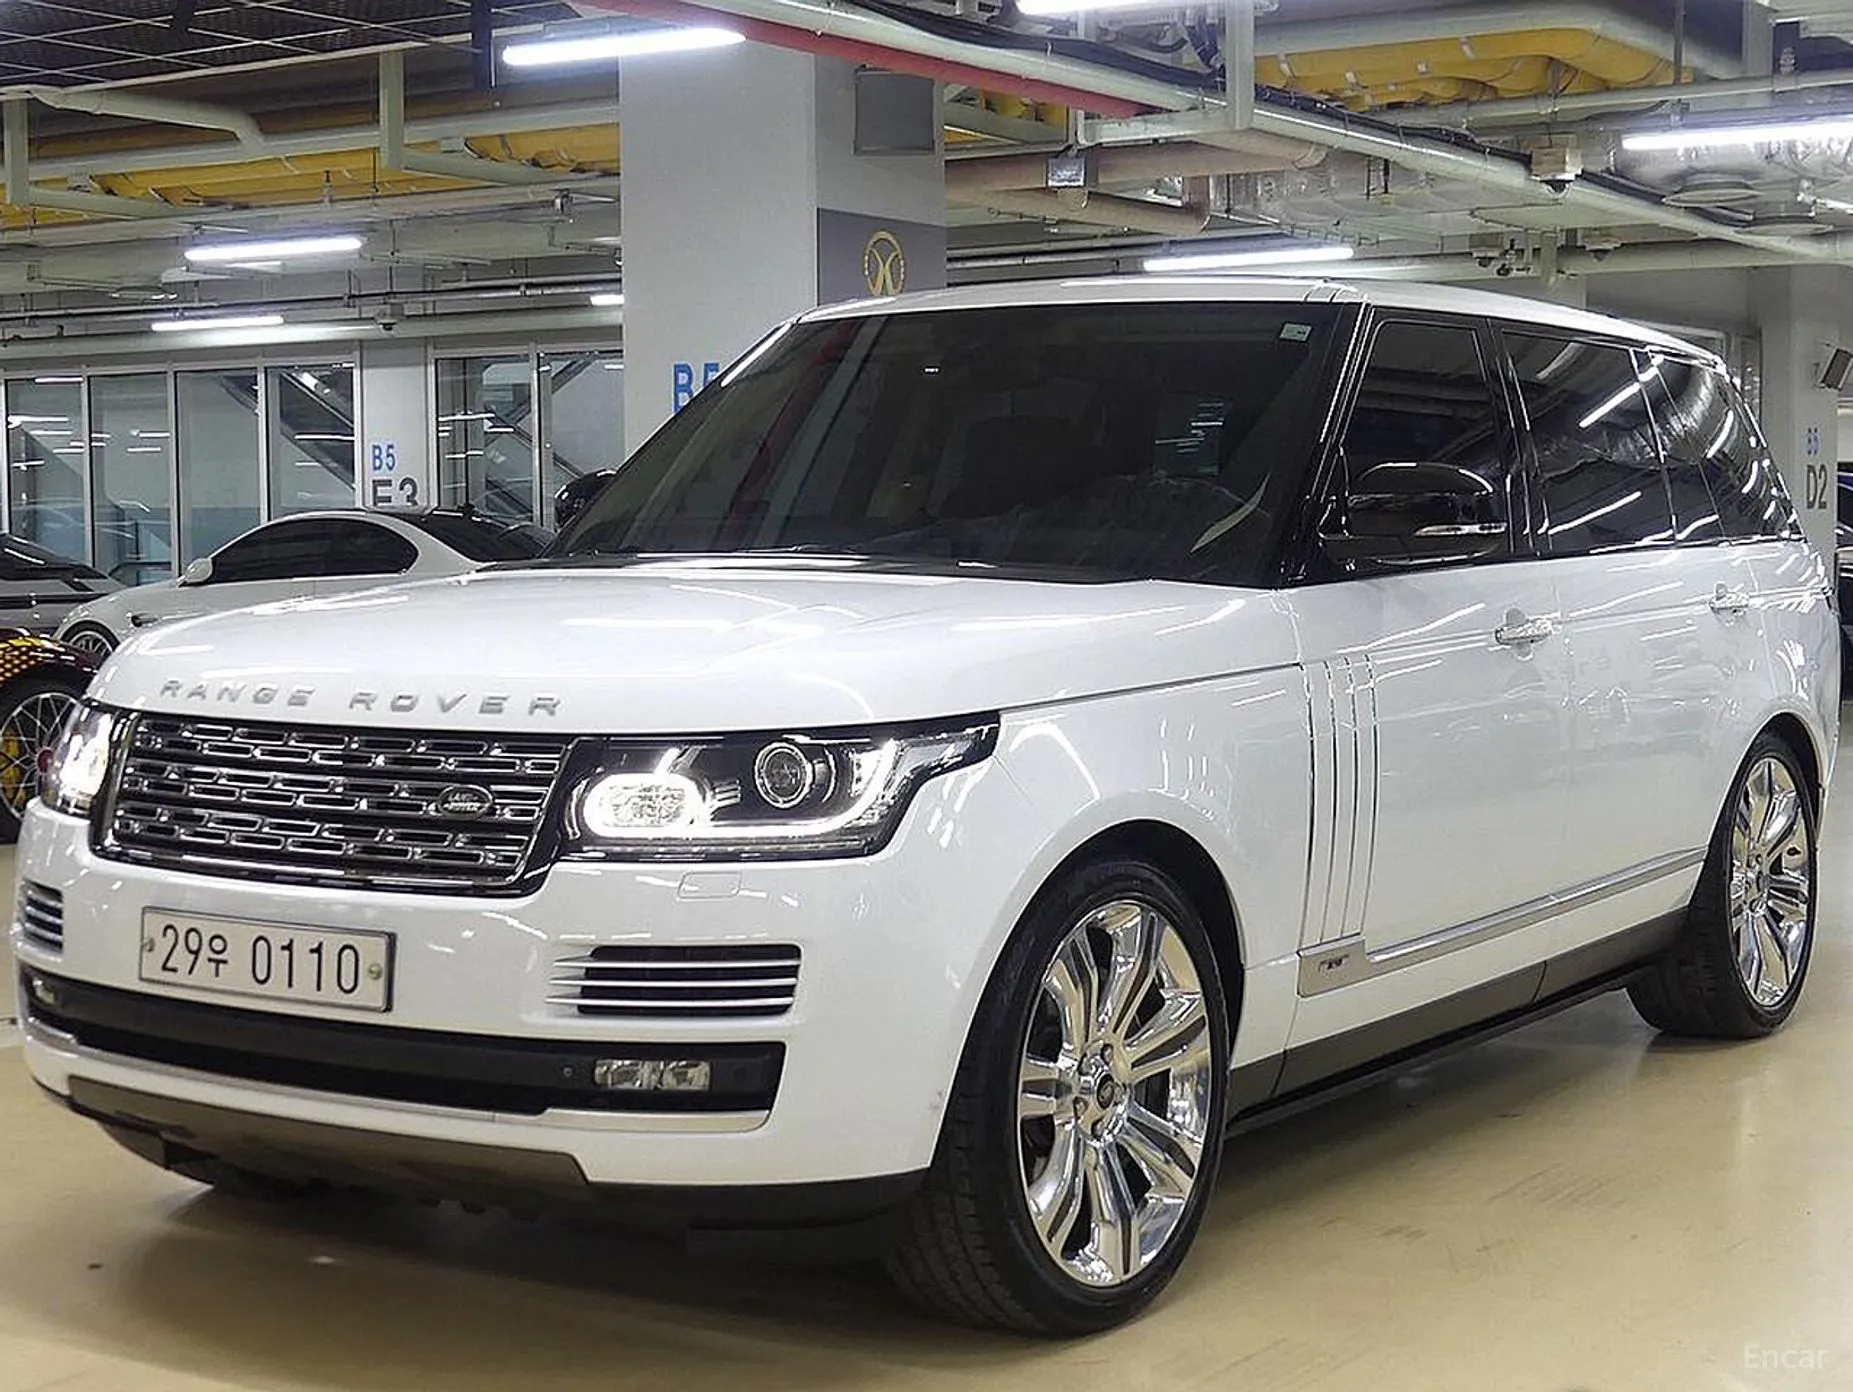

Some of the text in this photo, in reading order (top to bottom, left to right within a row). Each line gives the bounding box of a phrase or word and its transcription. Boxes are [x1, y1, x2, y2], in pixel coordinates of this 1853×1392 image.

[372, 444, 396, 471] B5
[1806, 464, 1828, 509] D2
[160, 679, 562, 716] RANGE ROVER
[162, 924, 359, 994] 29우 0110
